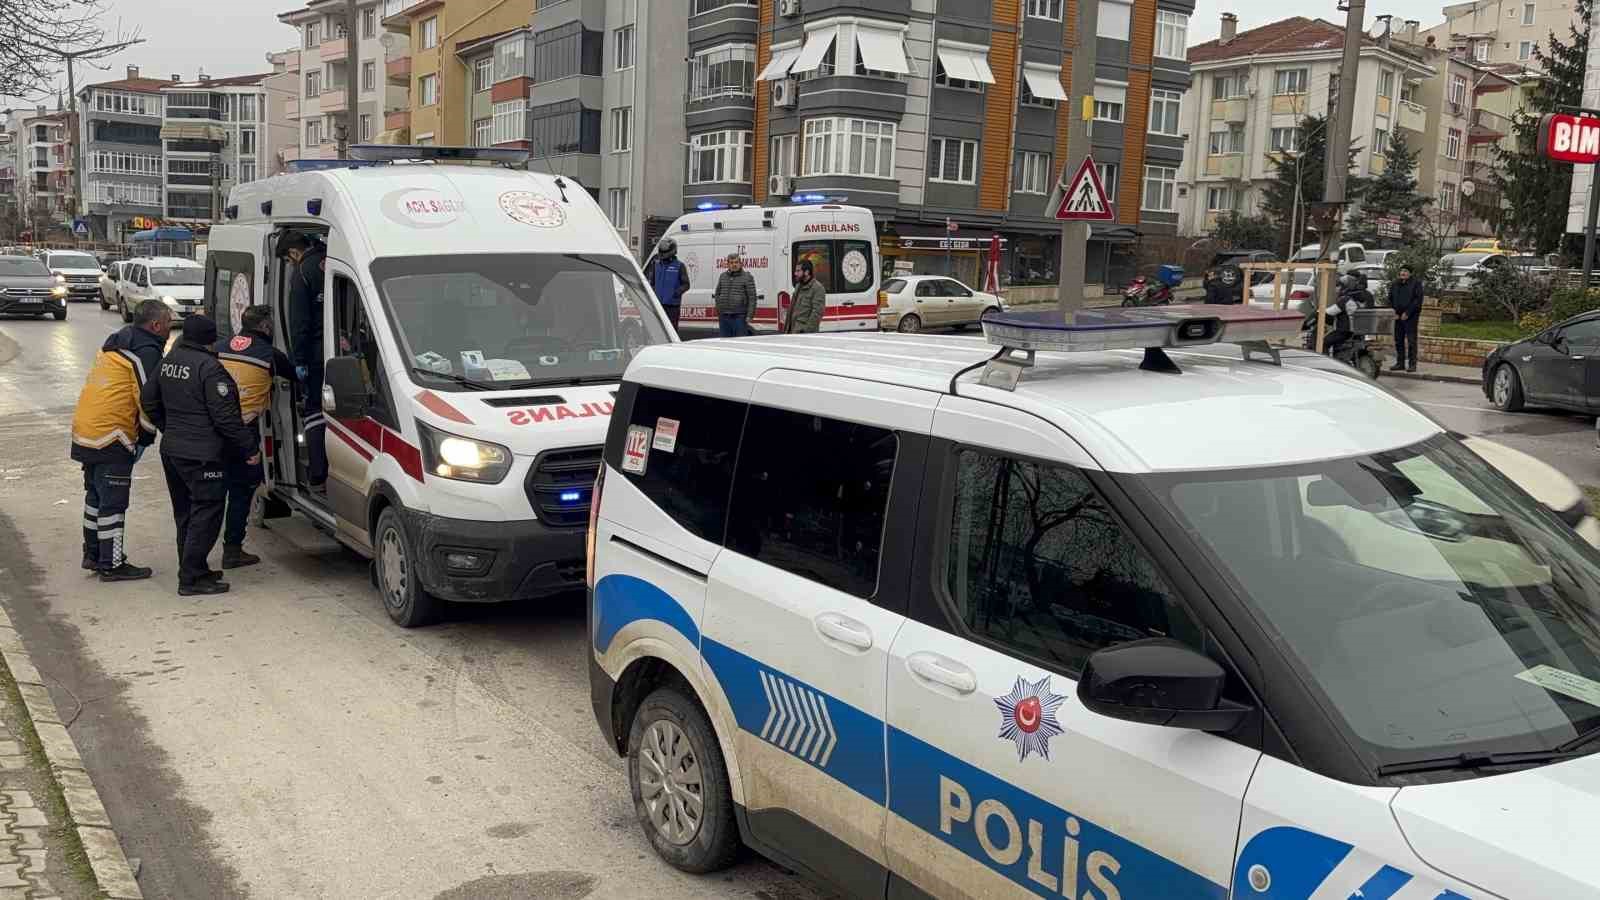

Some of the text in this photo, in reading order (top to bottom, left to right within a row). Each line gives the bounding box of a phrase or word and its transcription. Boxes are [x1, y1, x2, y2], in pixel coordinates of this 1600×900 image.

[1554, 117, 1600, 155] BİM
[804, 223, 860, 233] AMBULANS
[680, 307, 706, 317] BULANS
[160, 363, 190, 379] POLİS
[939, 773, 1122, 900] POLİS
